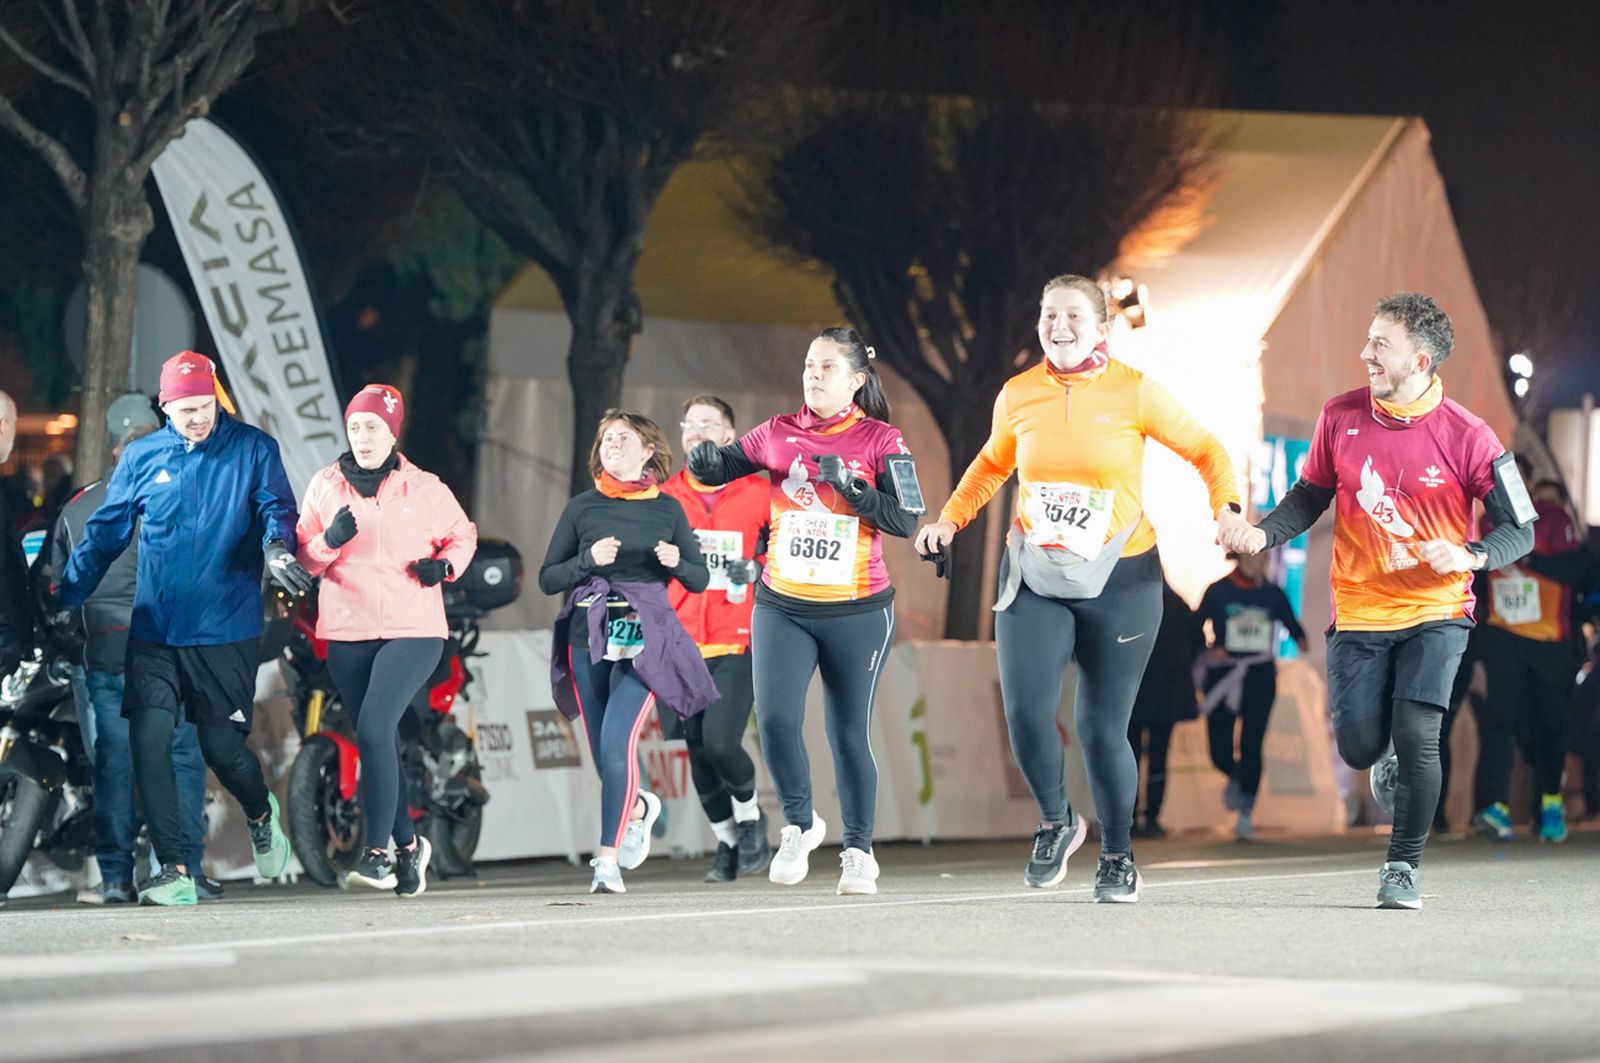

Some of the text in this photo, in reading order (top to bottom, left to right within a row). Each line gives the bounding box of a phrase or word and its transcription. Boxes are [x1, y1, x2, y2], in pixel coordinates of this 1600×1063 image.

[225, 181, 339, 446] JAPEMASA
[793, 486, 814, 507] 43
[1371, 501, 1394, 524] 43
[789, 536, 841, 561] 6362
